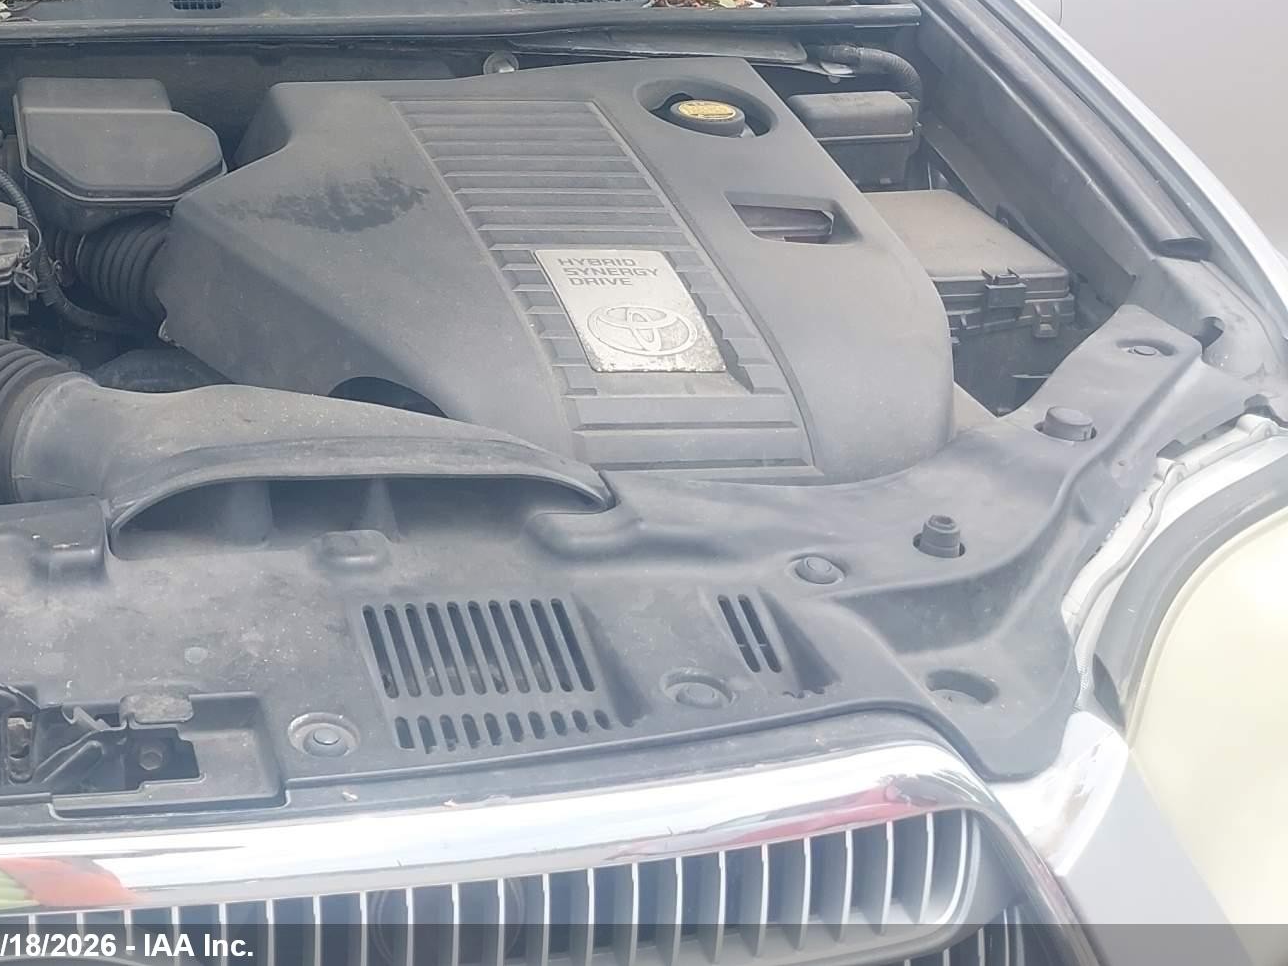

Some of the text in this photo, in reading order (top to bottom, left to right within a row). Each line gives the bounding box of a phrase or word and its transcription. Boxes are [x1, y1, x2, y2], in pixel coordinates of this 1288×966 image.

[557, 258, 636, 267] HYBRID
[563, 267, 658, 276] SYNERGY
[568, 277, 633, 286] DRIVE
